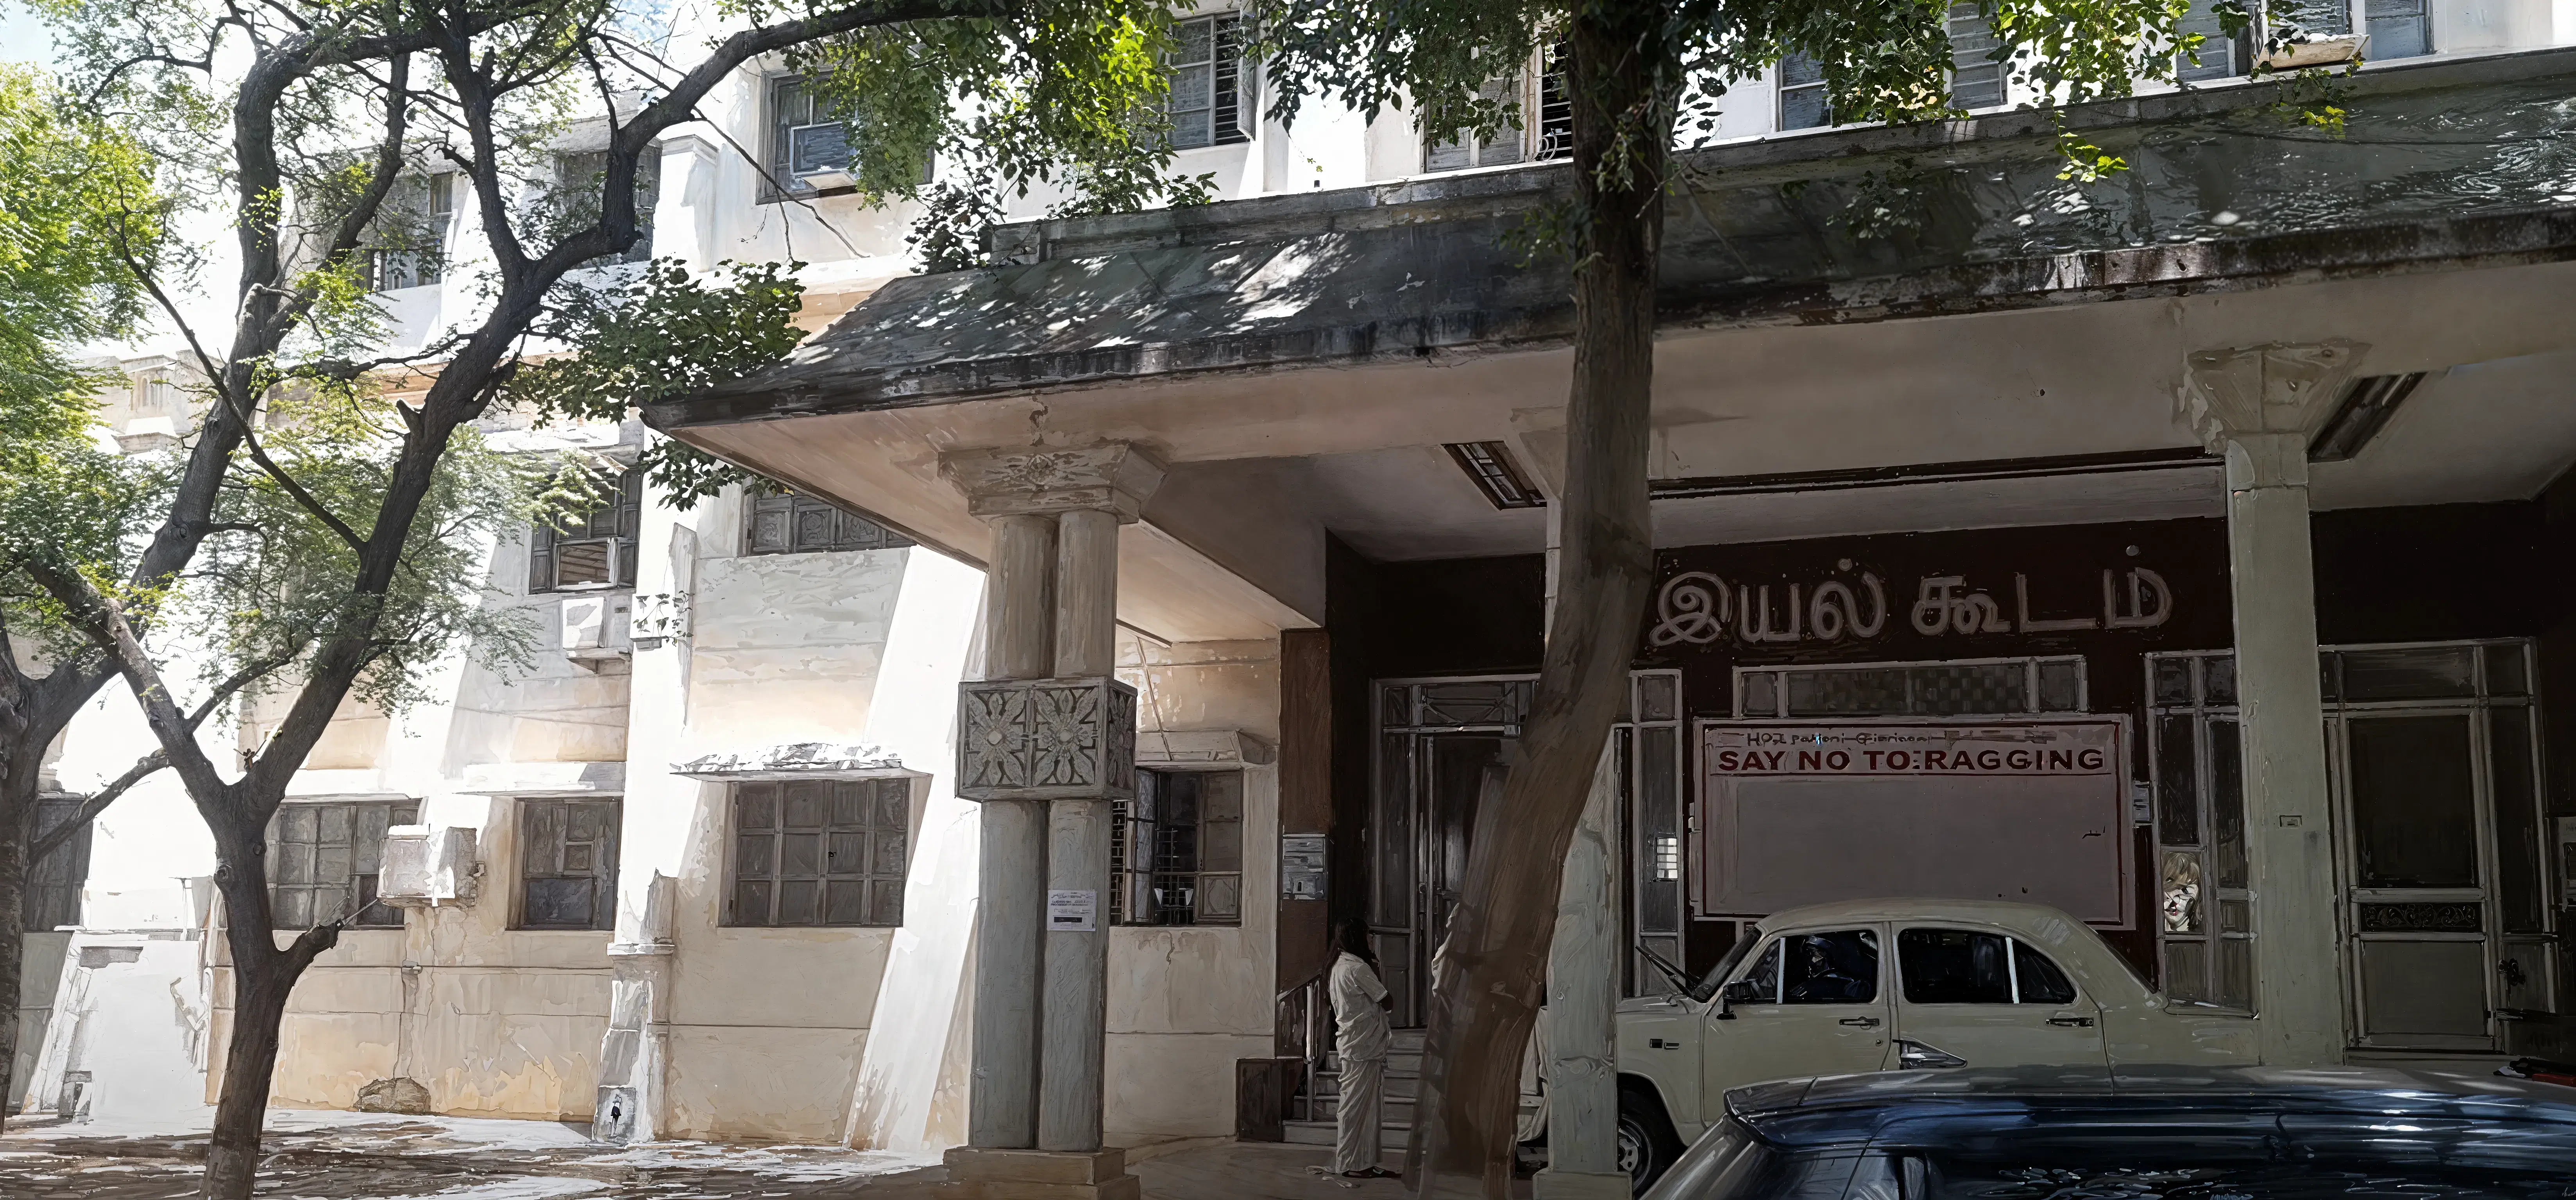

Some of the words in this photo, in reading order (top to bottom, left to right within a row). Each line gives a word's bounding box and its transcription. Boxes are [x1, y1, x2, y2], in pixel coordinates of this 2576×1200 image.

[1649, 559, 1886, 647] இயல்
[1718, 750, 1786, 771] SAY
[1798, 750, 1851, 771] NO
[1924, 749, 2104, 771] RAGGING
